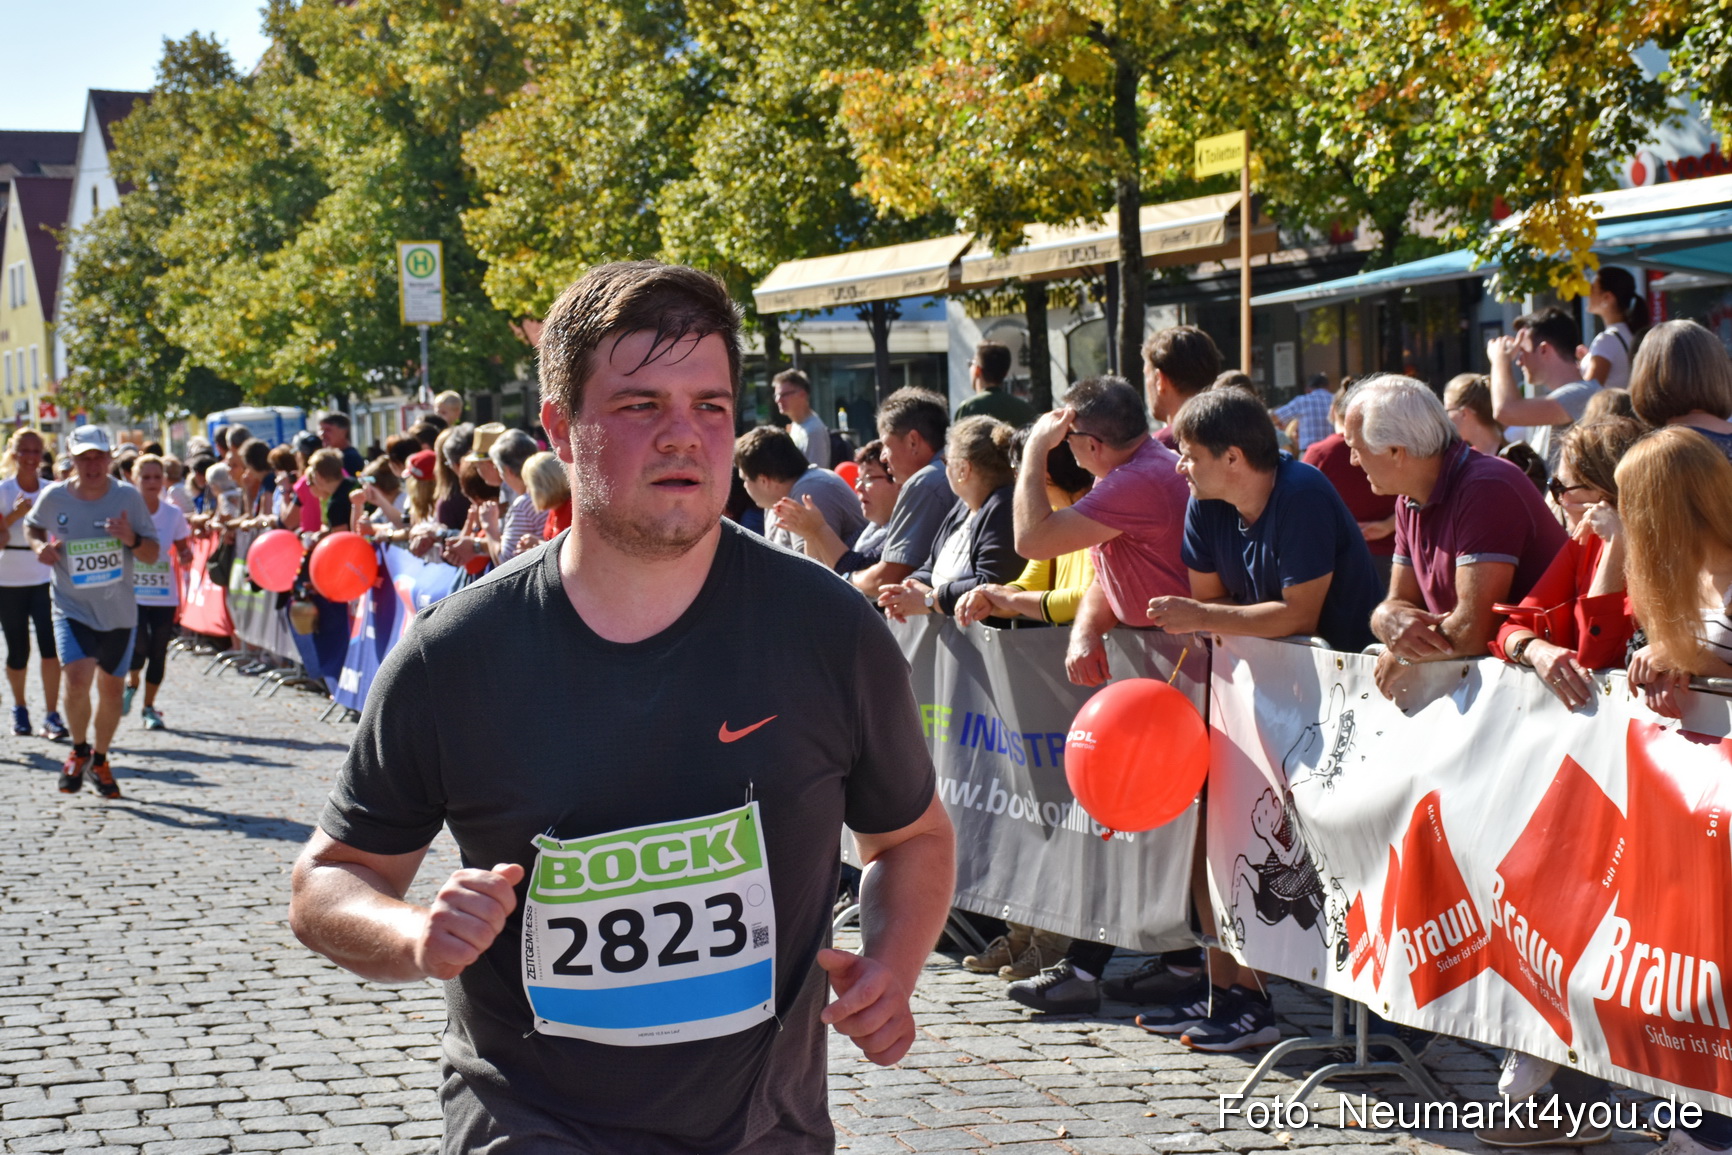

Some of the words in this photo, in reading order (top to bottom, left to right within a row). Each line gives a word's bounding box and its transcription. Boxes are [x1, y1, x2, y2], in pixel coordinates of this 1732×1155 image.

[1205, 146, 1242, 164] Toiletten
[75, 553, 118, 572] 2090
[537, 821, 743, 894] BOCK
[1602, 867, 1616, 888] Seit
[1612, 837, 1626, 865] 1929
[547, 892, 747, 976] 2823
[1396, 899, 1478, 976] Braun
[1436, 955, 1461, 973] Sicher
[1461, 946, 1471, 959] ist
[1489, 870, 1564, 999] Braun
[1600, 915, 1731, 1031] Braun
[1645, 1024, 1686, 1051] Sicher
[1688, 1034, 1709, 1054] ist
